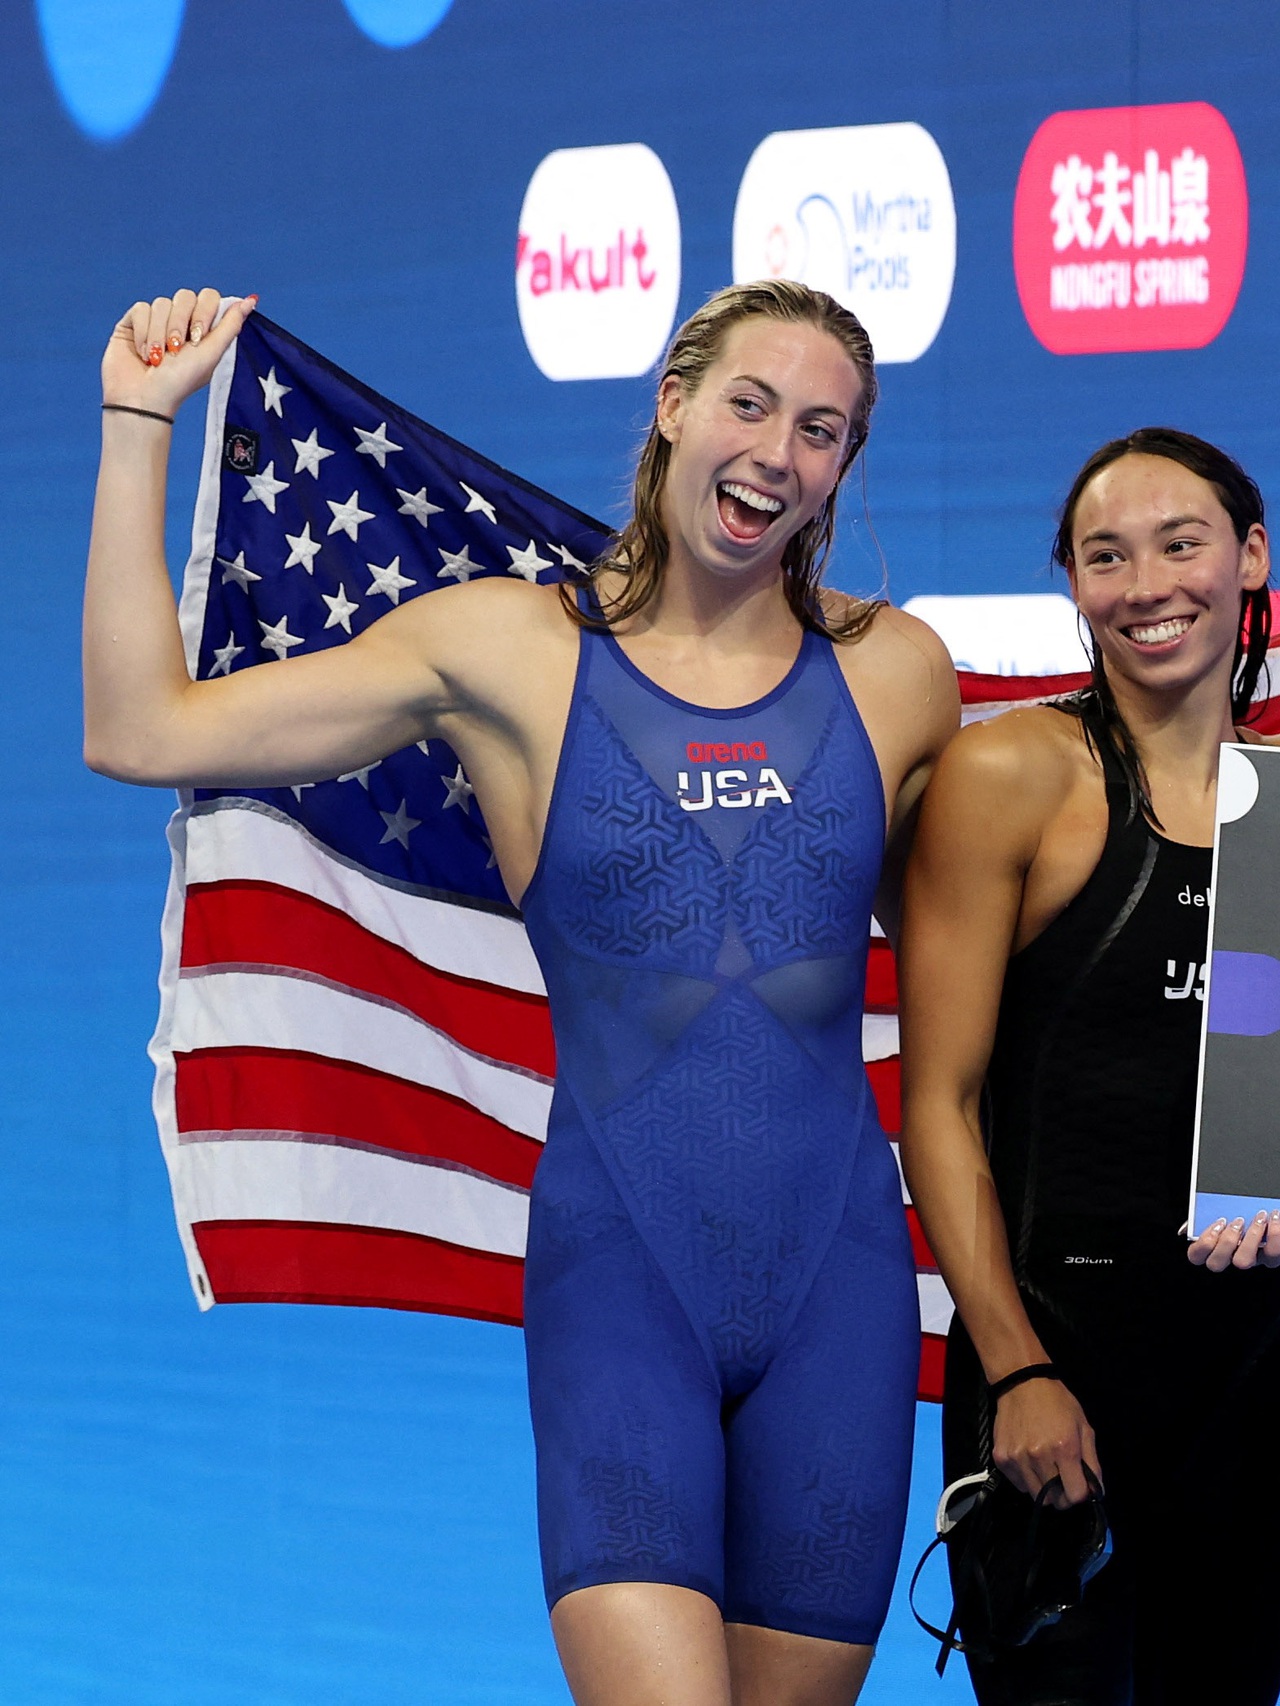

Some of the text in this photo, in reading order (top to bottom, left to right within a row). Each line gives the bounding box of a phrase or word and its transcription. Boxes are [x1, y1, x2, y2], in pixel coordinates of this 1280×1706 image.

[1050, 146, 1211, 253] 农夫山泉
[1133, 254, 1210, 308] SPRING
[686, 740, 768, 764] arena
[677, 768, 796, 812] USA
